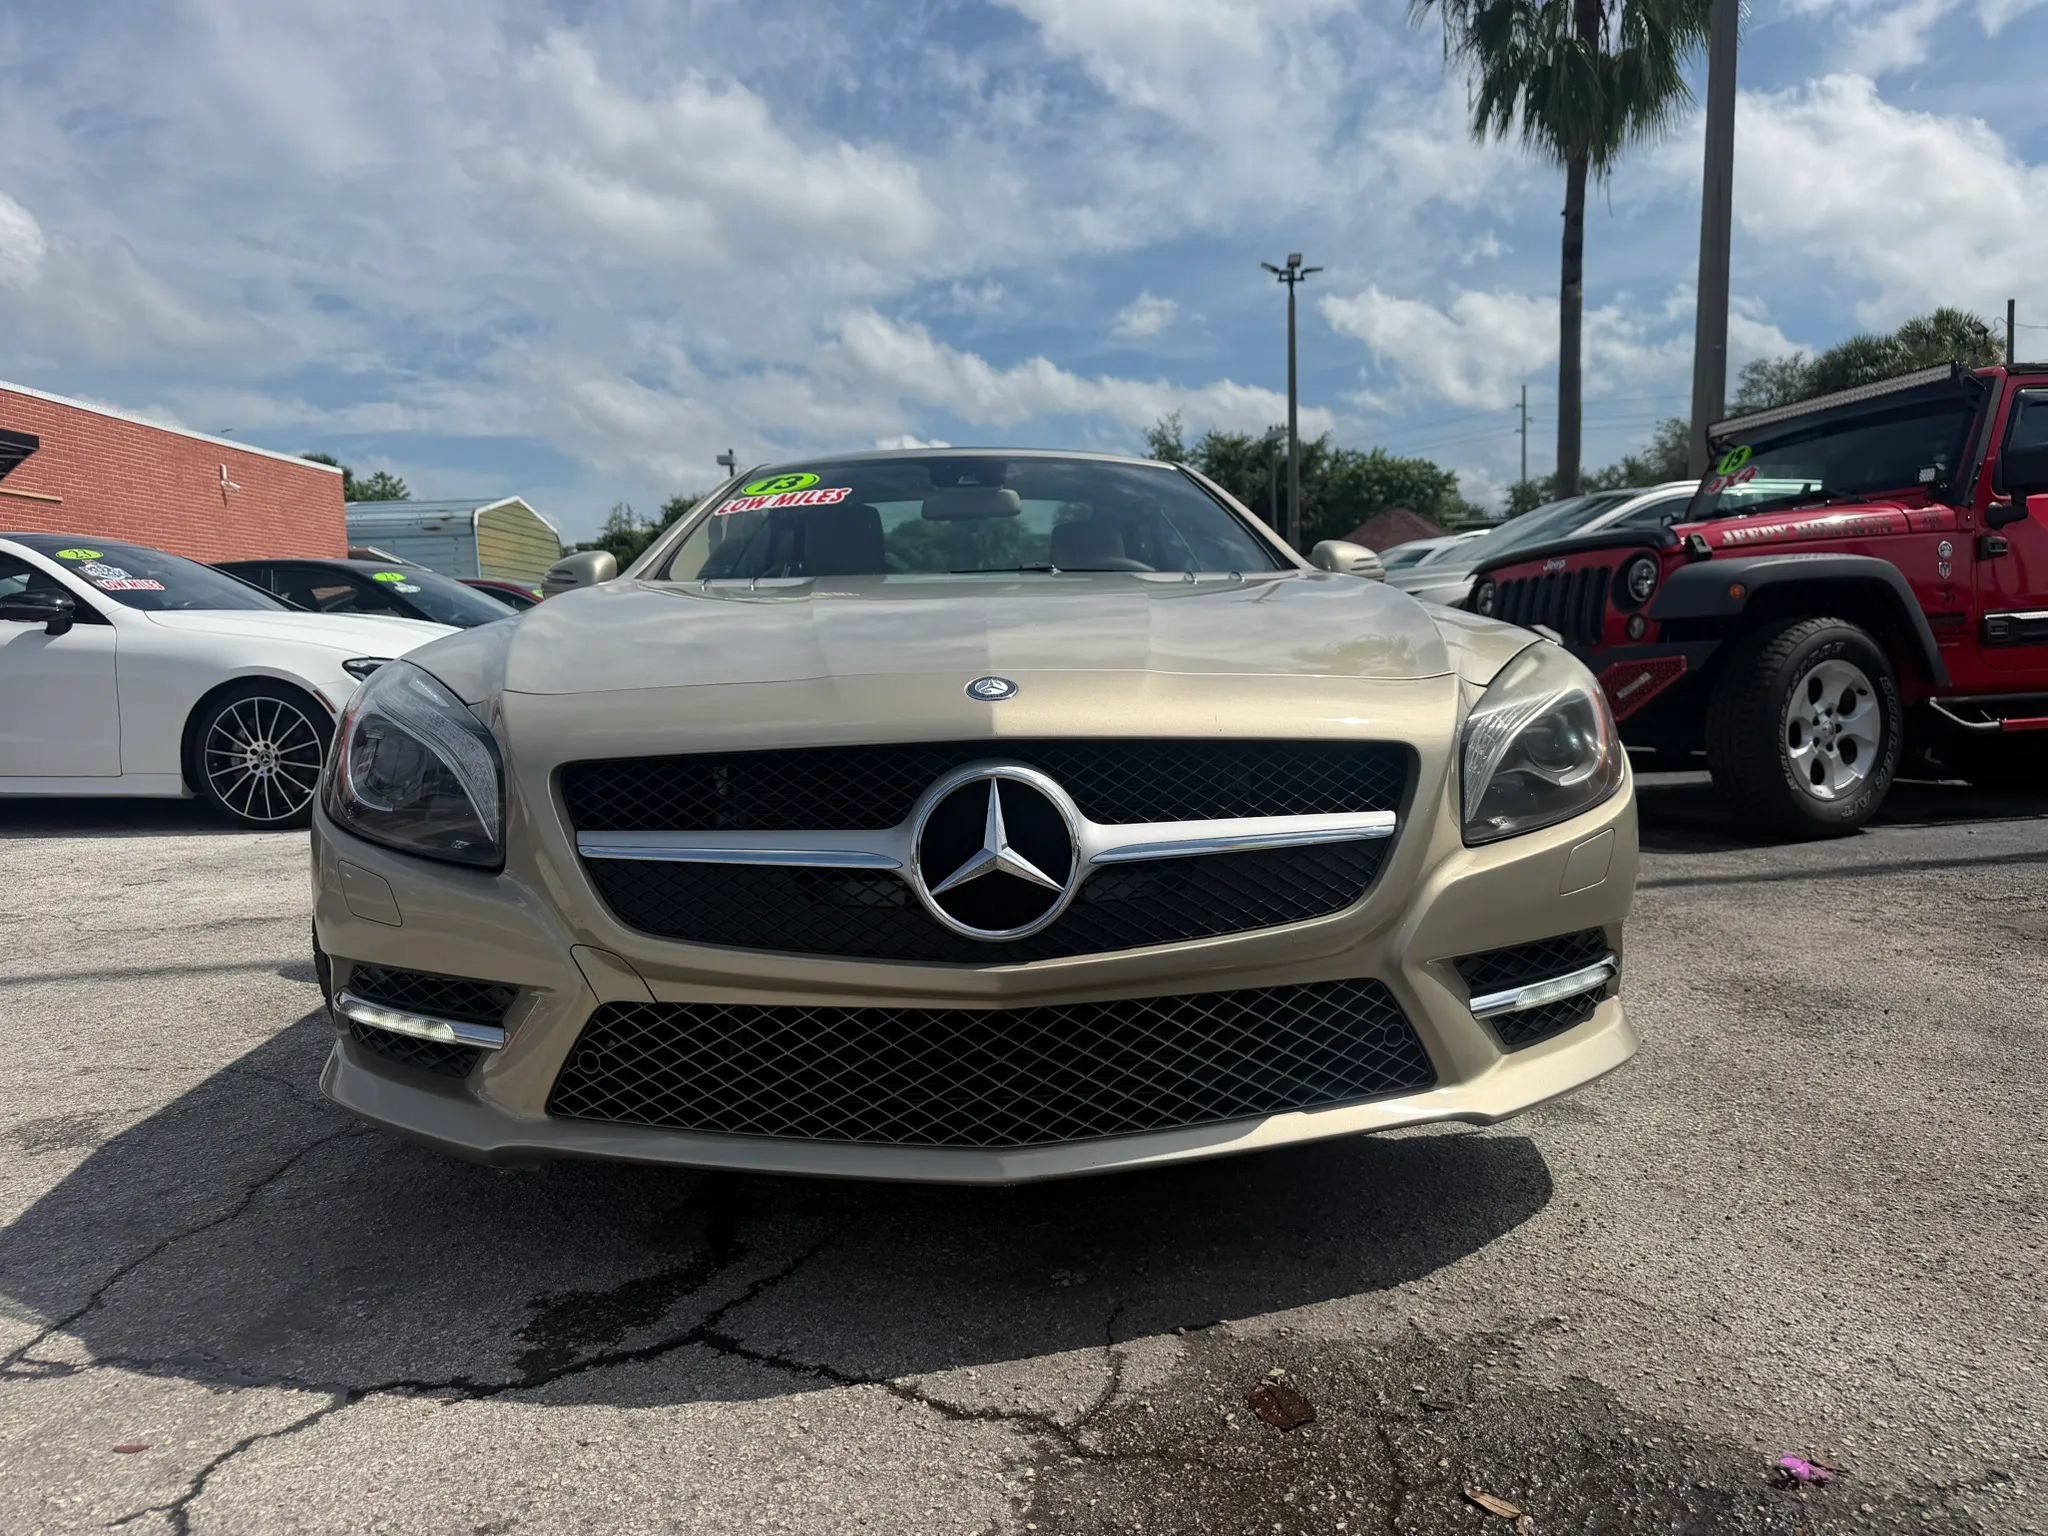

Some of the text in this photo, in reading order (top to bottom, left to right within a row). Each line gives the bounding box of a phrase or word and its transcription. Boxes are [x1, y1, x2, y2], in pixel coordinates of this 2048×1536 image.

[1723, 448, 1747, 471] 15
[756, 475, 805, 492] 13
[716, 488, 852, 514] LOW MILES
[1543, 559, 1566, 574] Jeep
